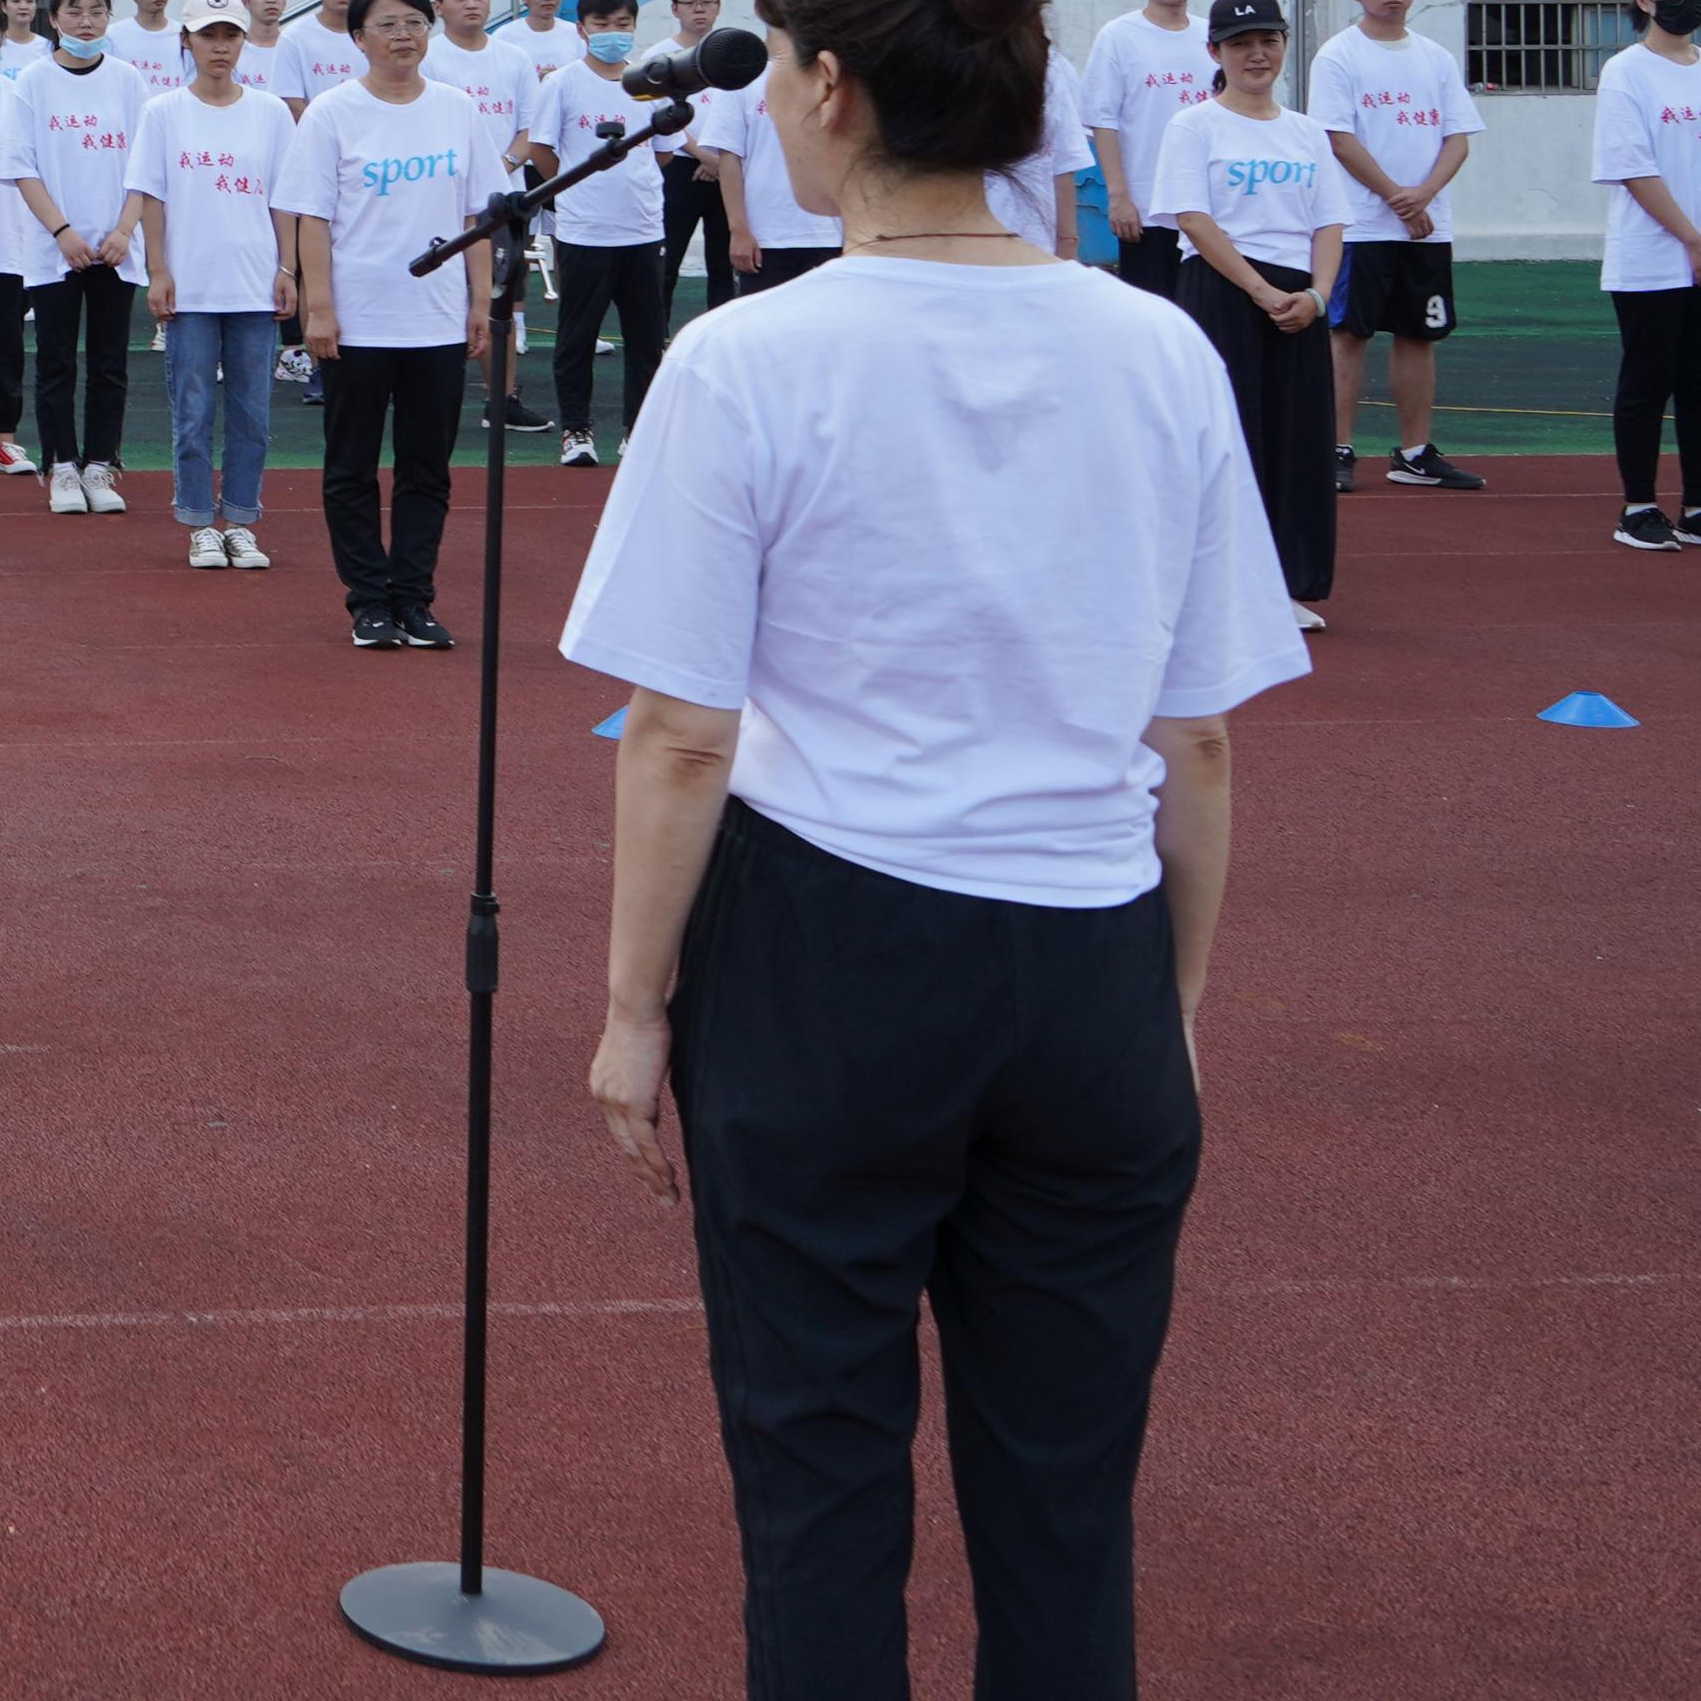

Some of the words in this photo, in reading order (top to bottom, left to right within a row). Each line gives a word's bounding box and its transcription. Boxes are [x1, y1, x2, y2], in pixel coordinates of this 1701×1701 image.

[1234, 4, 1256, 16] LA
[1145, 72, 1194, 88] 我运动
[1179, 89, 1209, 105] 我健
[1362, 91, 1410, 108] 我运动
[48, 113, 98, 131] 我运动
[1397, 107, 1441, 128] 我健康
[178, 150, 236, 170] 我运动
[362, 148, 458, 196] sport
[1227, 158, 1317, 196] sport
[1425, 295, 1447, 329] 9
